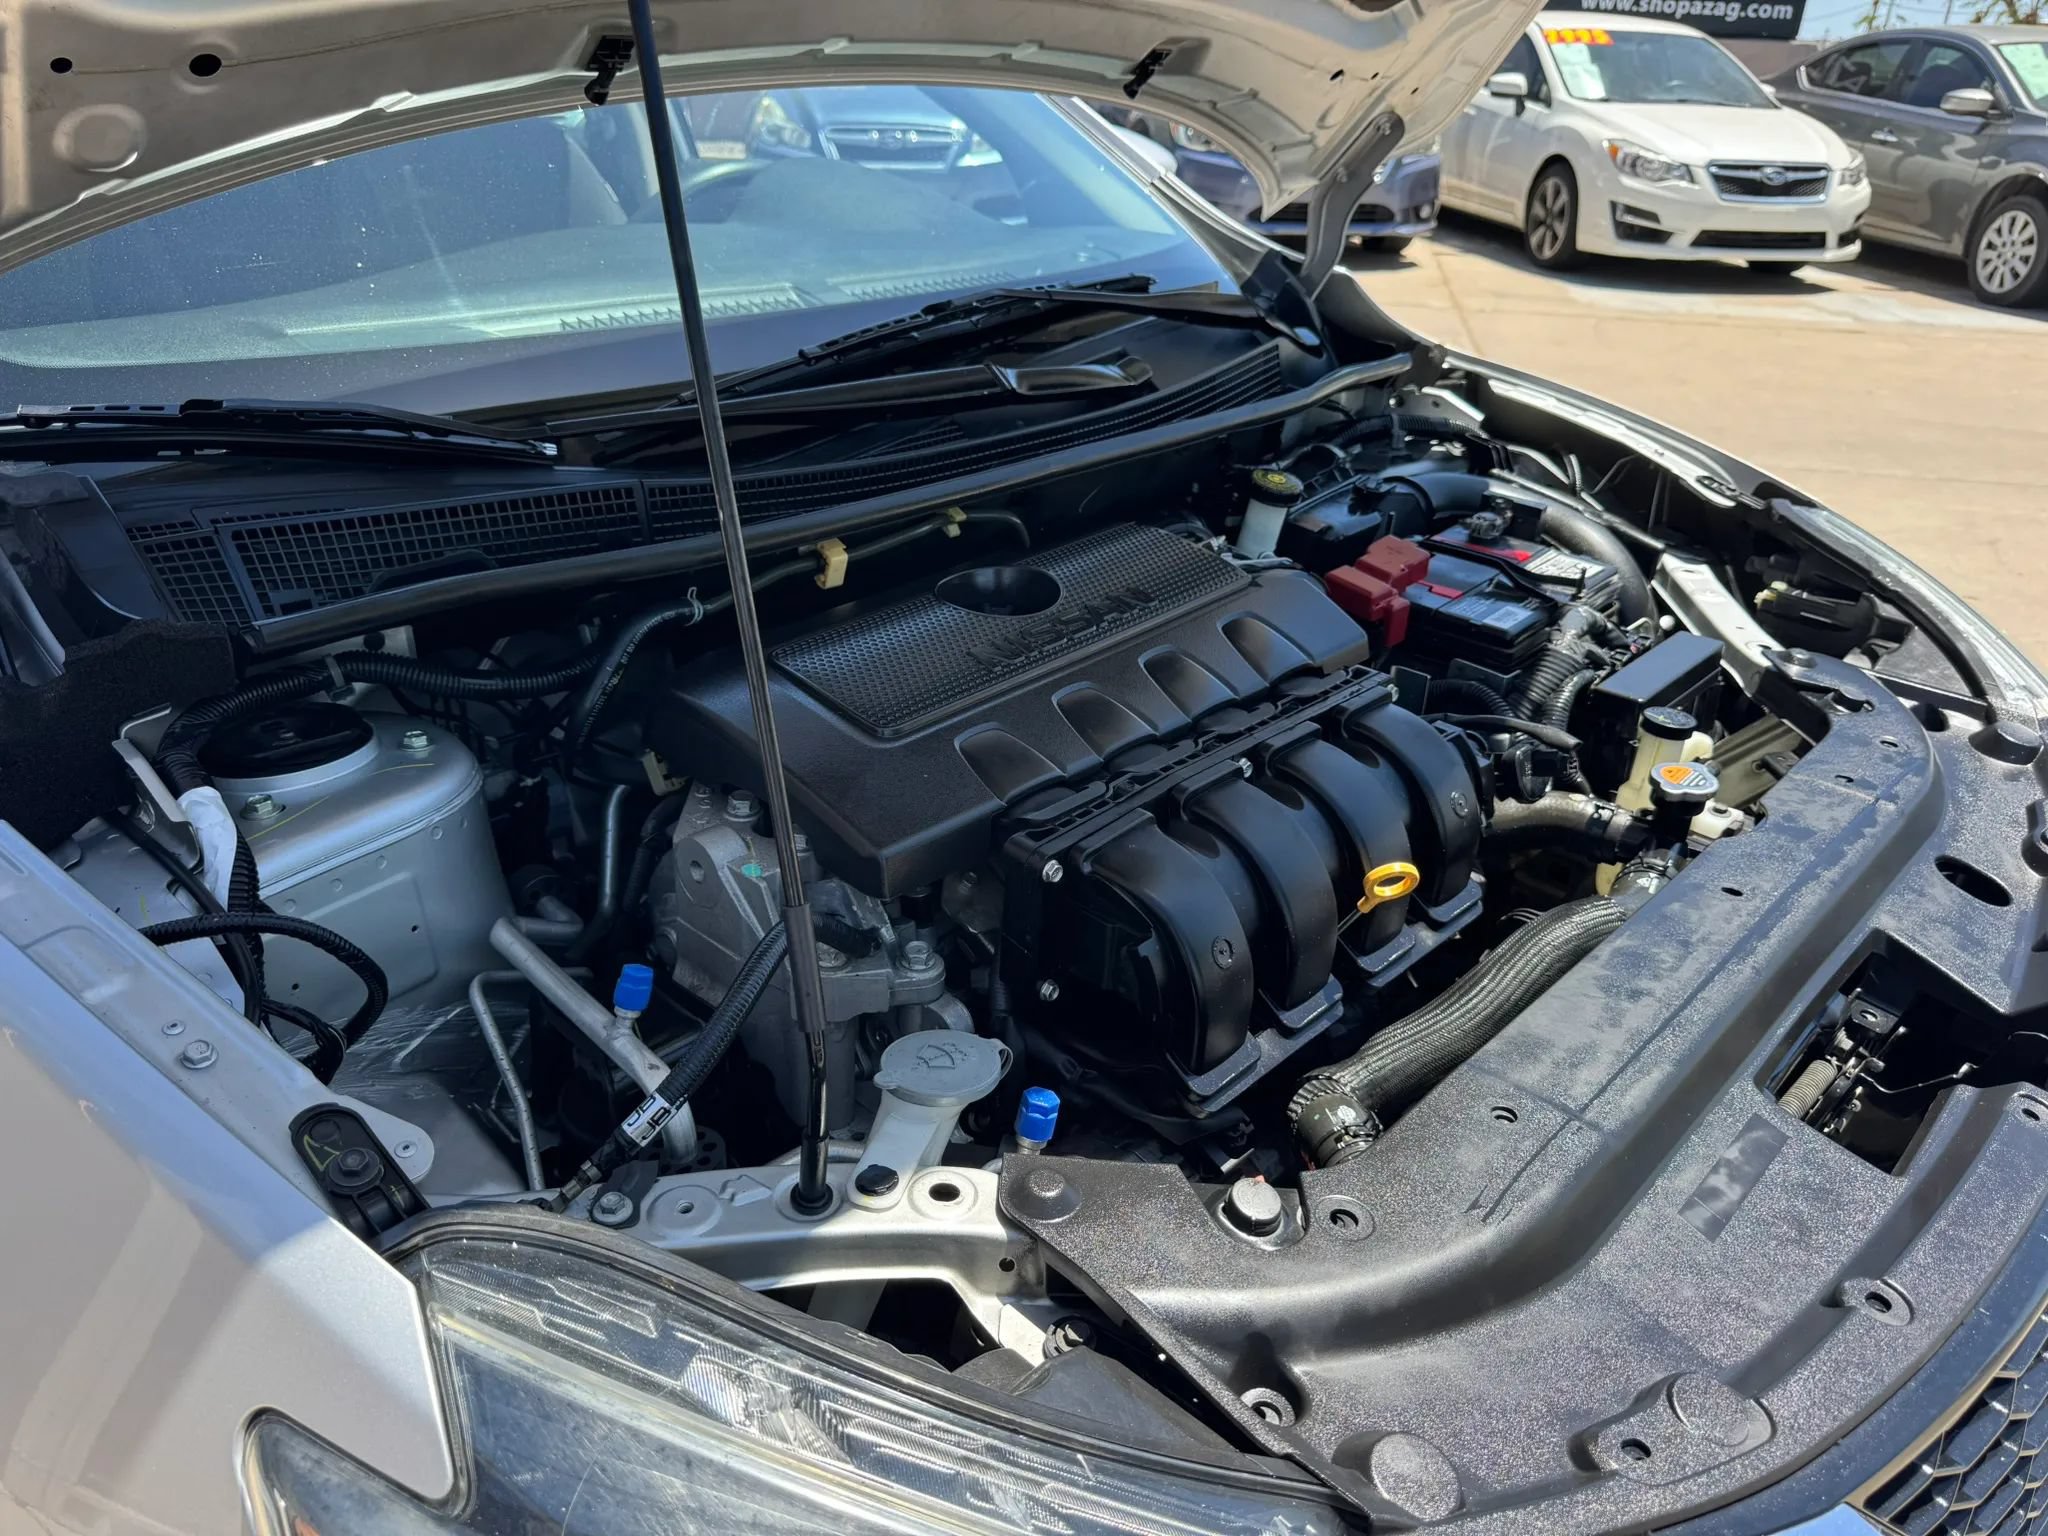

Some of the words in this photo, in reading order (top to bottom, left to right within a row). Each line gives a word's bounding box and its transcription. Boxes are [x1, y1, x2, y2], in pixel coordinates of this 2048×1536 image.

[1581, 0, 1793, 21] www.shopazag.com
[968, 587, 1158, 673] NISSAN
[641, 1106, 672, 1141] JB
